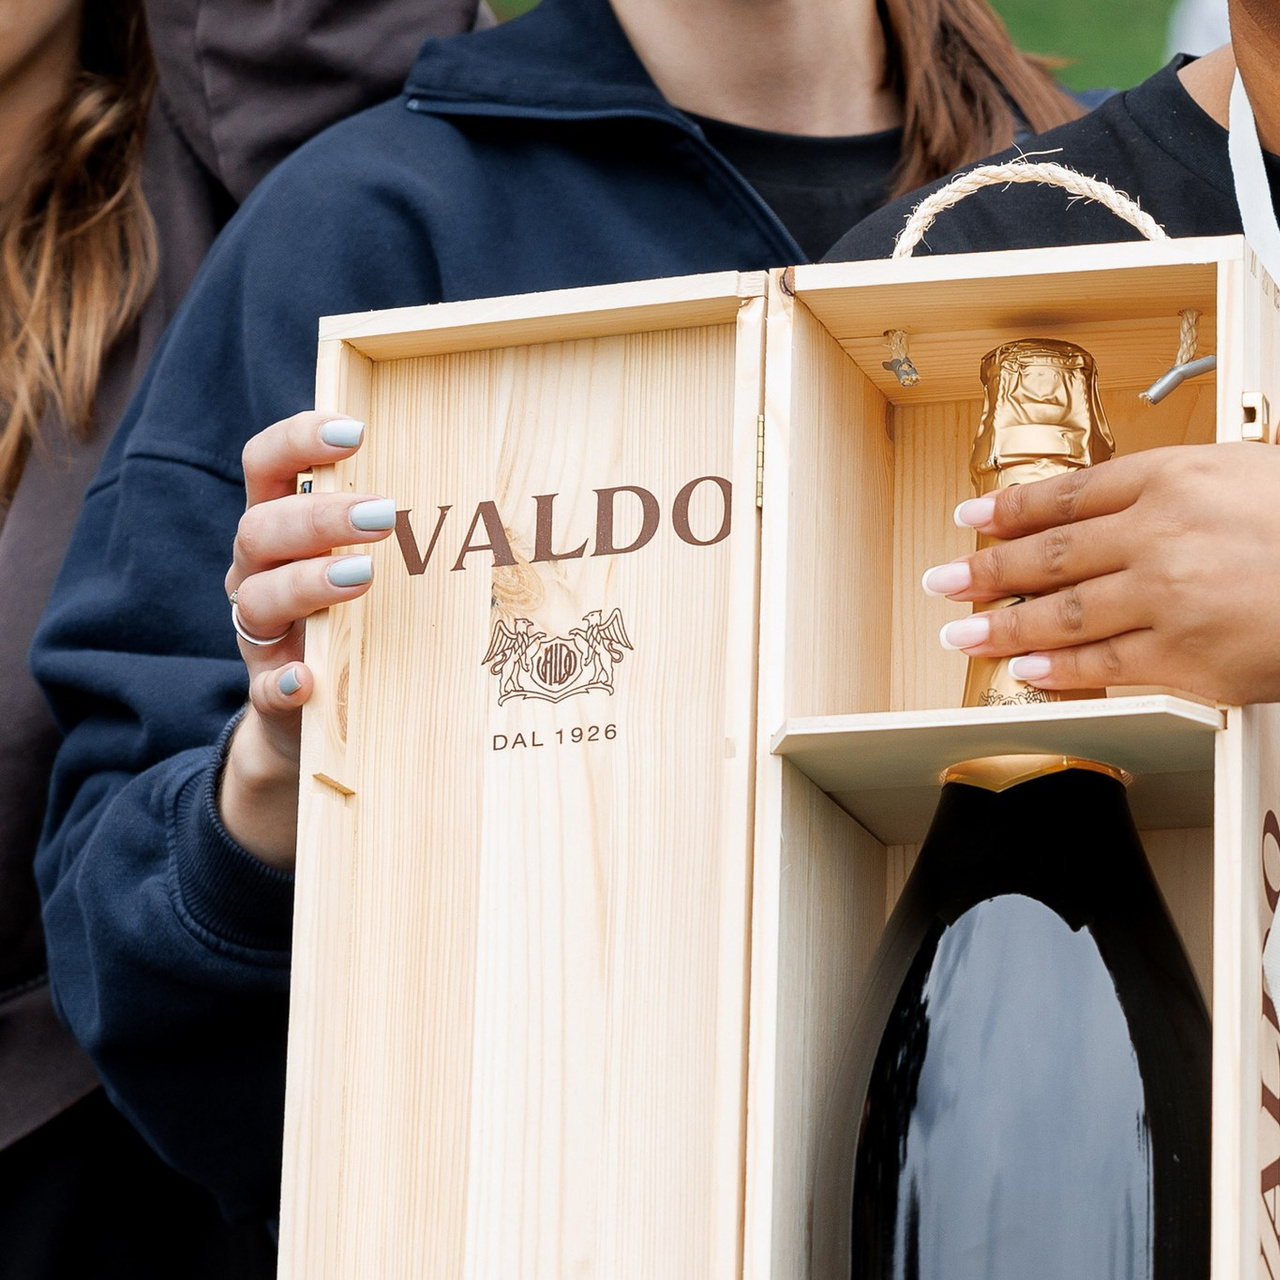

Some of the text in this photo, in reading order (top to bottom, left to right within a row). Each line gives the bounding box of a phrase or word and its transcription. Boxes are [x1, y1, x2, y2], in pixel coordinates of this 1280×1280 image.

[394, 476, 733, 576] VALDO
[493, 723, 618, 751] DAL 1926
